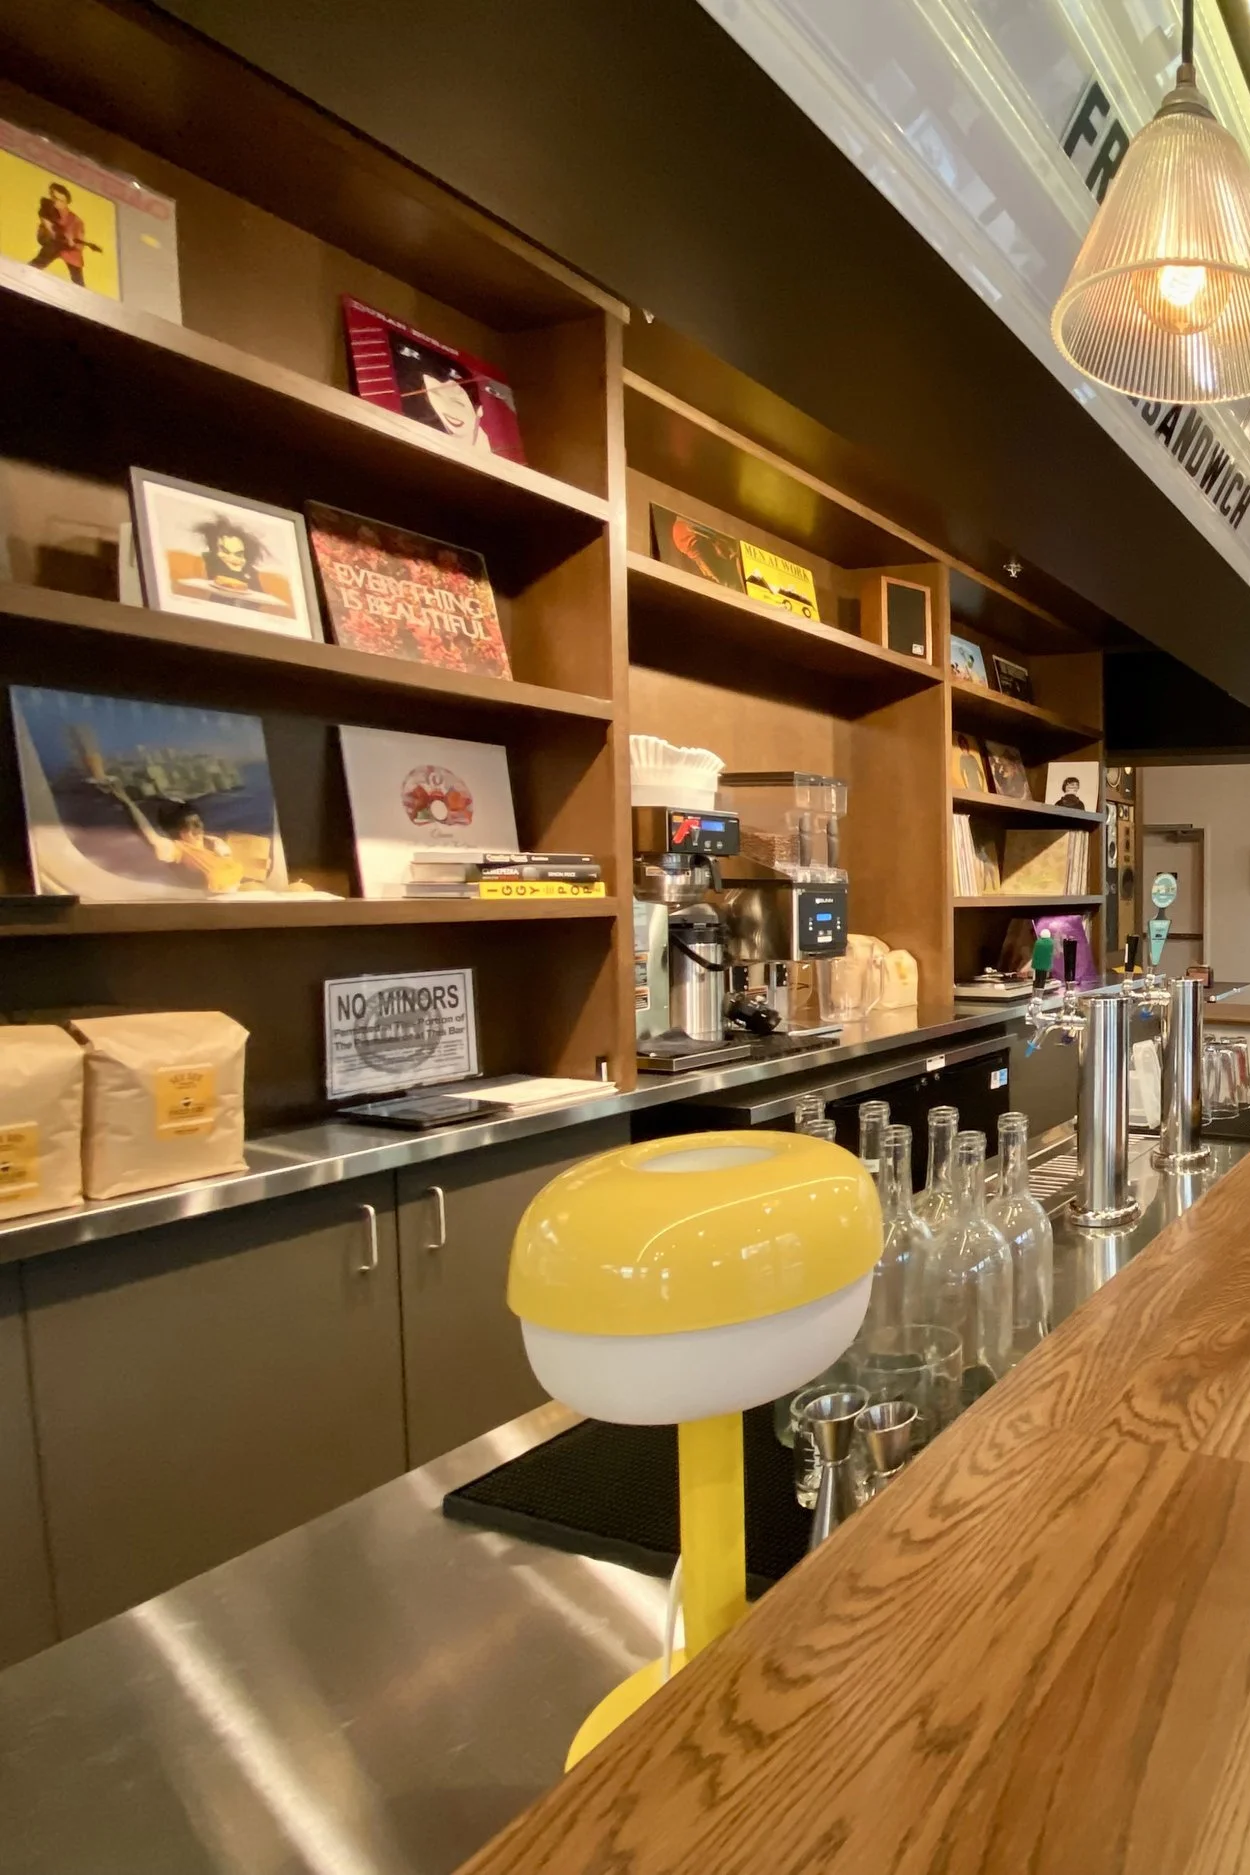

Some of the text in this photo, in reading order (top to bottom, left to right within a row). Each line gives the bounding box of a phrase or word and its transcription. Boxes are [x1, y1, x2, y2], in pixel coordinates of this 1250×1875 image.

[332, 561, 484, 619] EVERYTHING
[339, 587, 492, 641] IS BEAUTIFUL
[337, 985, 460, 1021] NO MINORS
[418, 1015, 454, 1026] Portion
[455, 1013, 465, 1022] of
[334, 1041, 352, 1050] The
[448, 1026, 465, 1035] Bar
